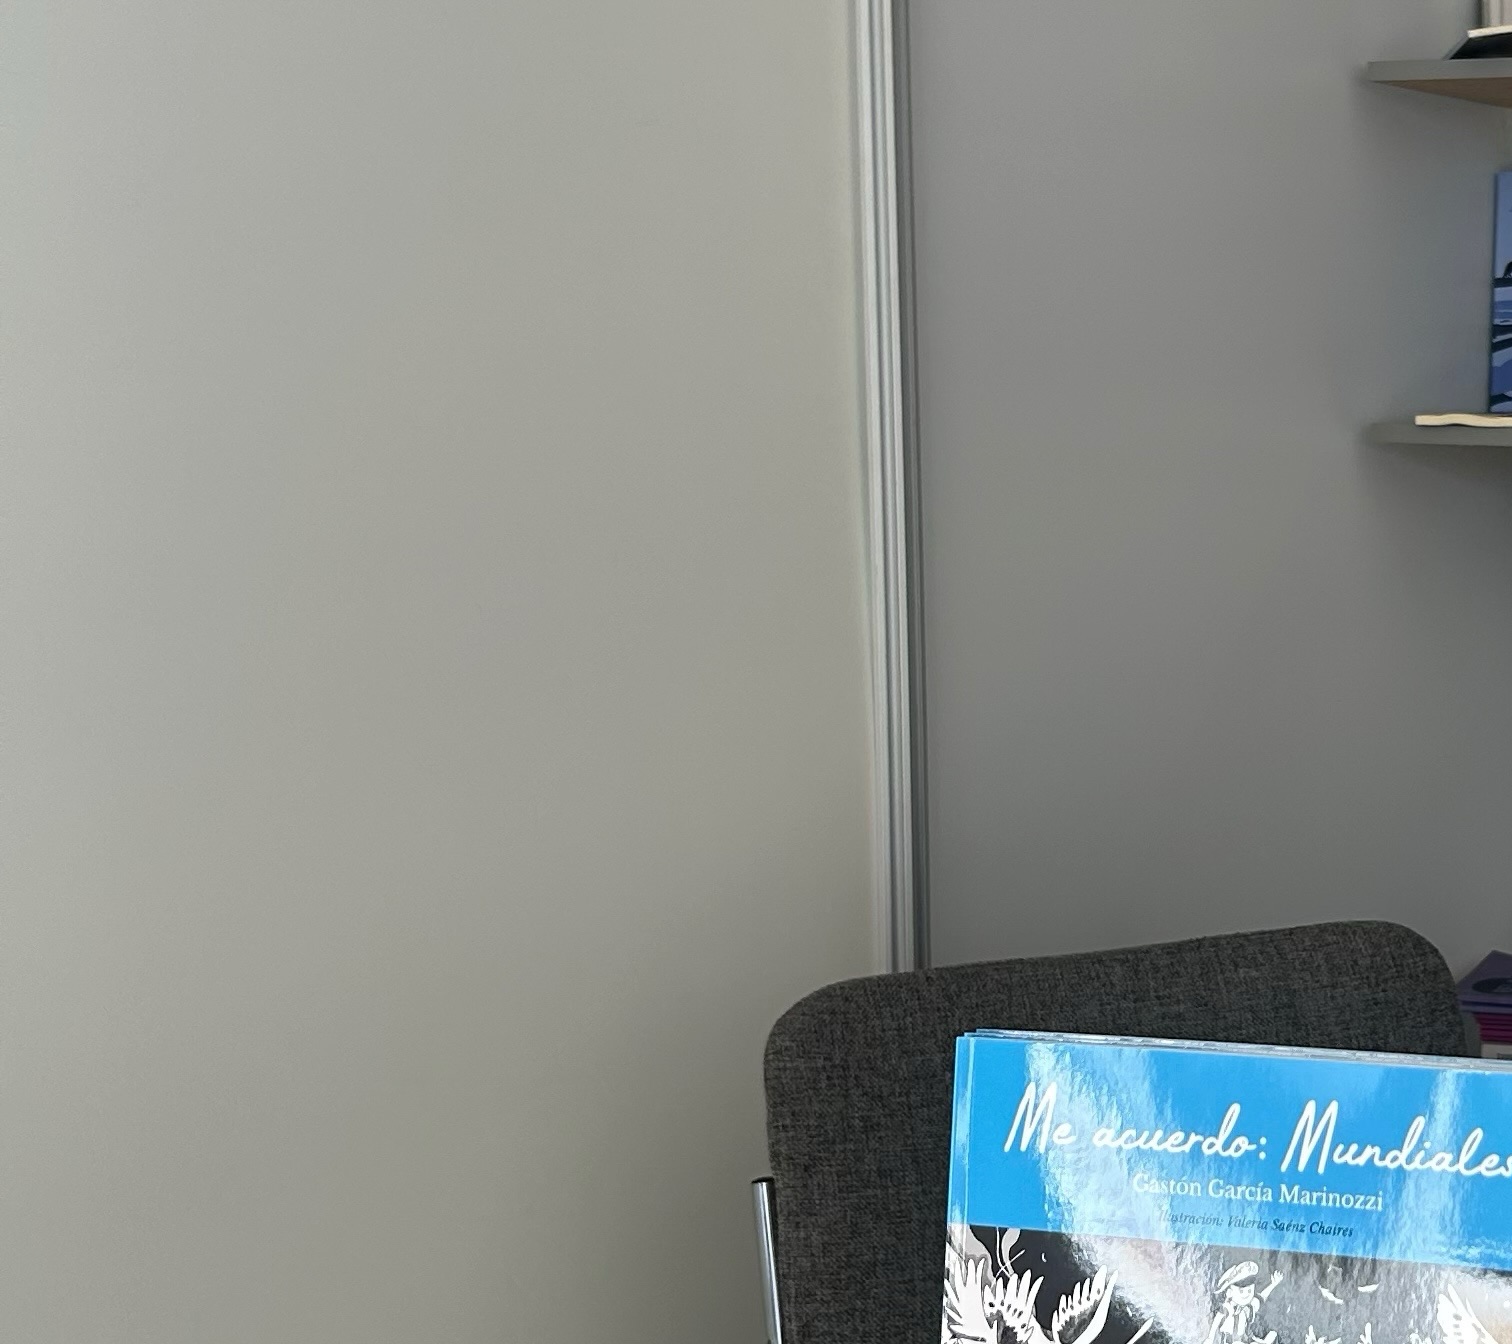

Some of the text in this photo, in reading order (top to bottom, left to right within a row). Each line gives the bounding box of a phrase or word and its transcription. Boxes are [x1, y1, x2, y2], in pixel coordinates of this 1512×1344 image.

[1004, 1082, 1074, 1155] Me
[1092, 1103, 1267, 1160] acuerdo:
[1132, 1172, 1383, 1212] Gastón García Marinozzi
[1227, 1214, 1268, 1234] Valeria
[1308, 1220, 1354, 1239] Chaires
